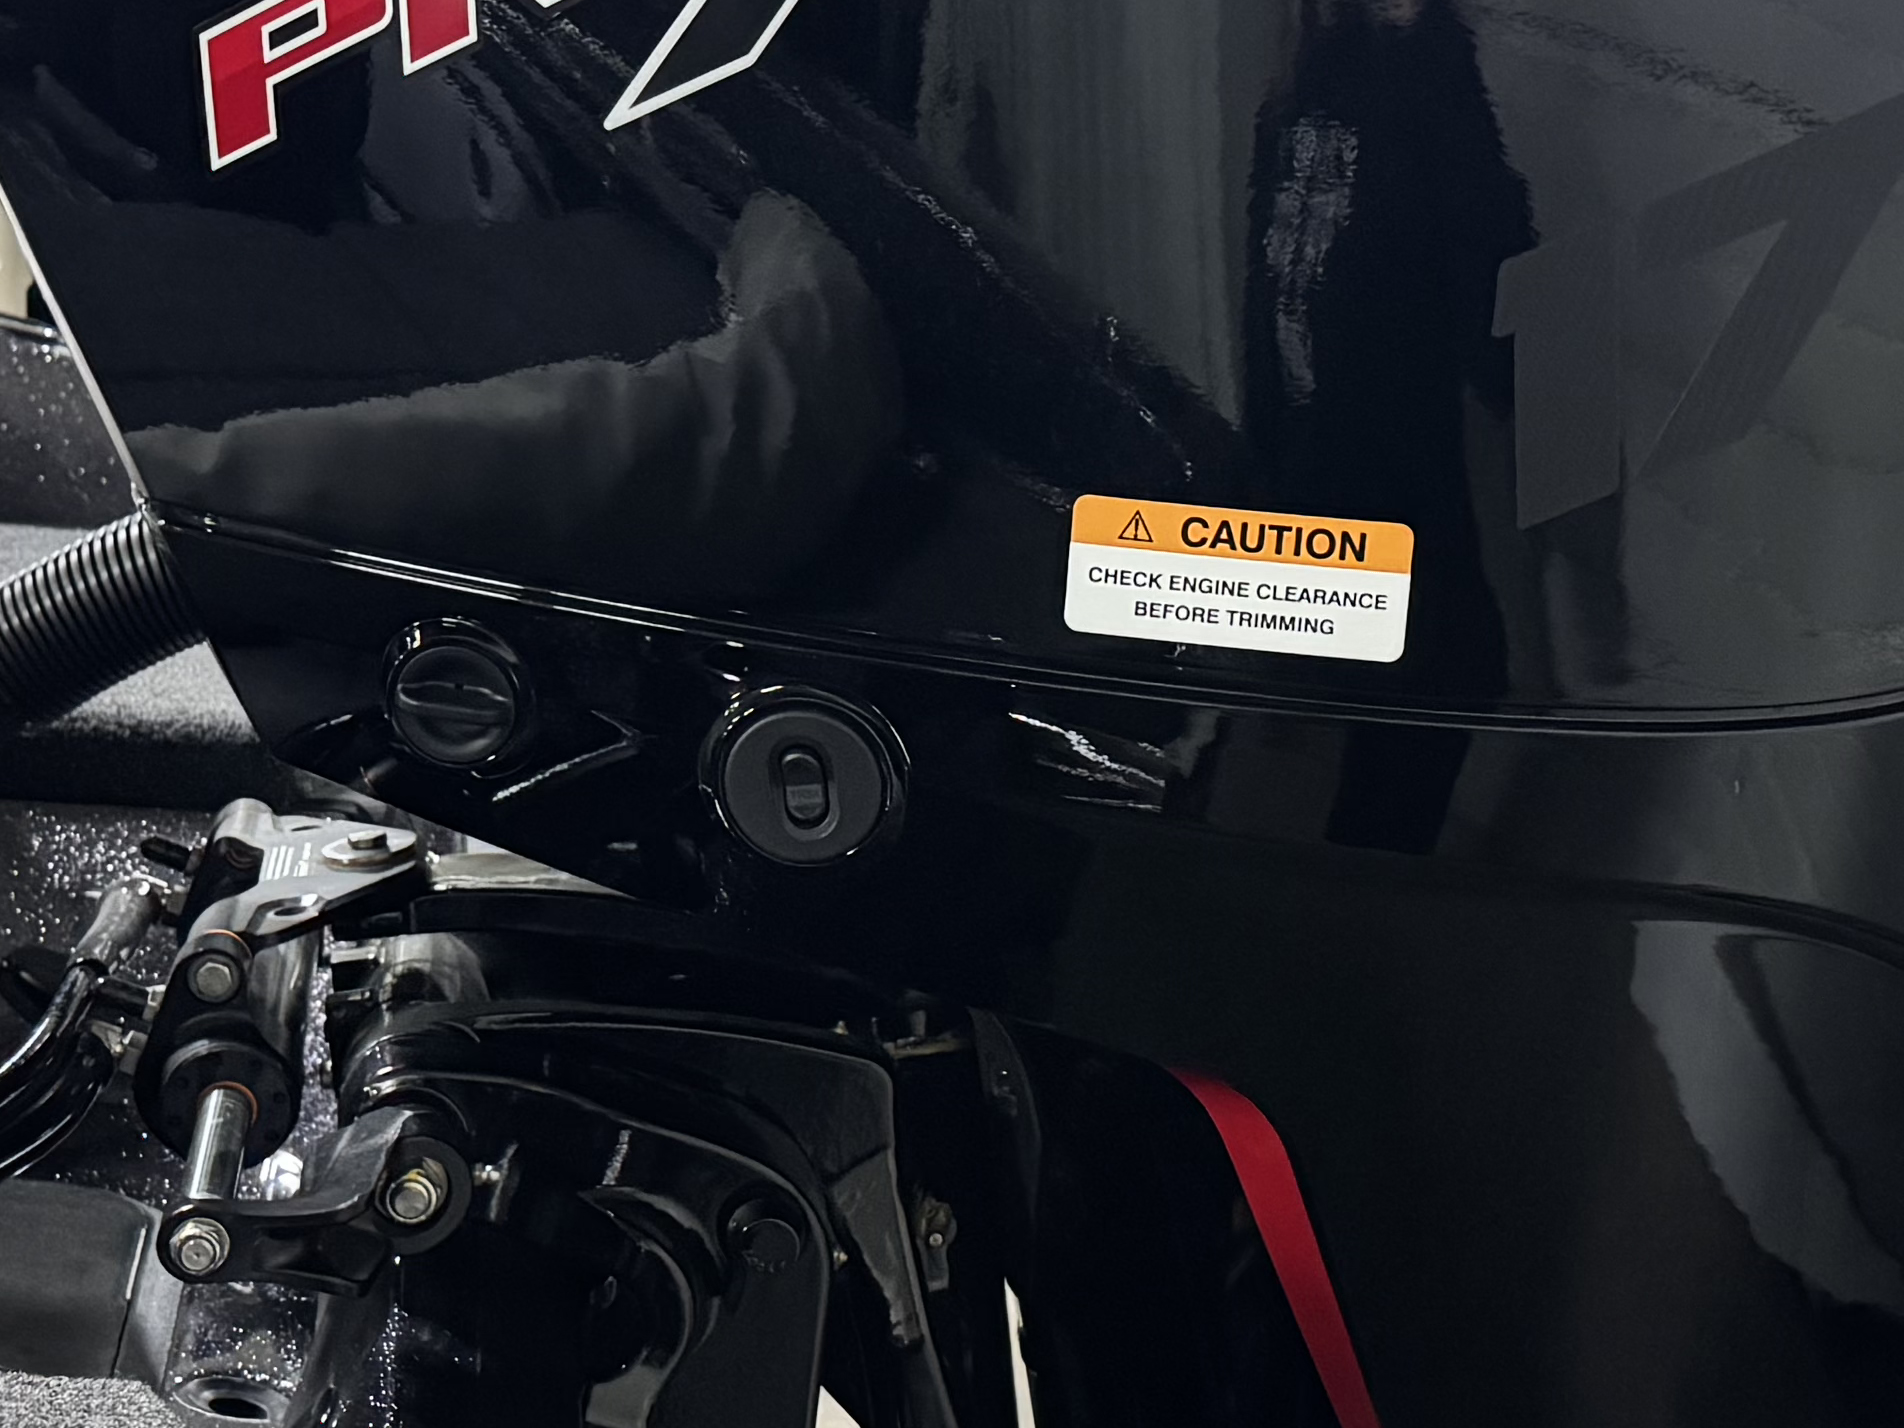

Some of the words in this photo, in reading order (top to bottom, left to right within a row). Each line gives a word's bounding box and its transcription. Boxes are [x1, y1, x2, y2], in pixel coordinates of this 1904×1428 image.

[1181, 517, 1367, 562] CAUTION
[1088, 567, 1163, 590] CHECK
[1169, 575, 1250, 598] ENGINE
[1256, 583, 1388, 610] CLEARANCE
[1134, 601, 1220, 624] BEFORE
[1226, 610, 1335, 636] TRIMMING
